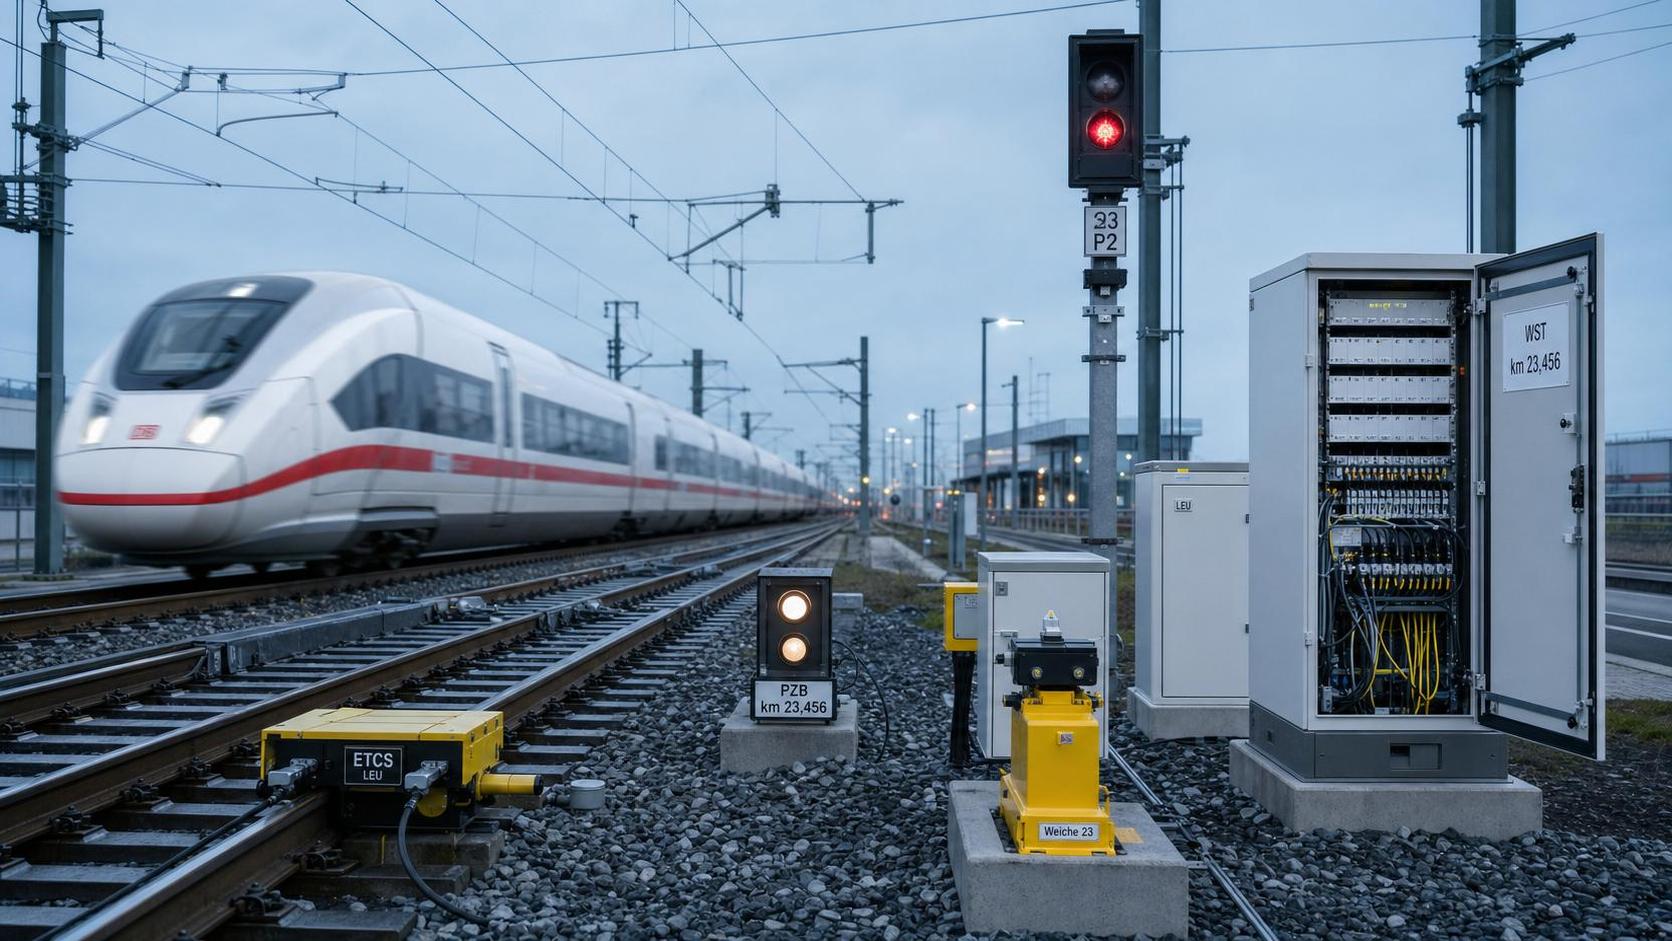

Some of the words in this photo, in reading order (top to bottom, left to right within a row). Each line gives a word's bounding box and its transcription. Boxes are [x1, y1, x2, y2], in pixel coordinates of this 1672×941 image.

[1094, 233, 1117, 250] P2
[1525, 322, 1547, 342] WST
[1510, 358, 1524, 375] km
[1527, 352, 1561, 376] 23,456
[1175, 501, 1191, 510] LEU
[781, 684, 808, 697] PZB
[761, 700, 780, 713] km
[784, 701, 827, 715] 23,456
[353, 752, 394, 768] ETCS
[363, 770, 383, 780] LEU
[1044, 826, 1079, 837] Weiche
[1081, 827, 1094, 837] 23
